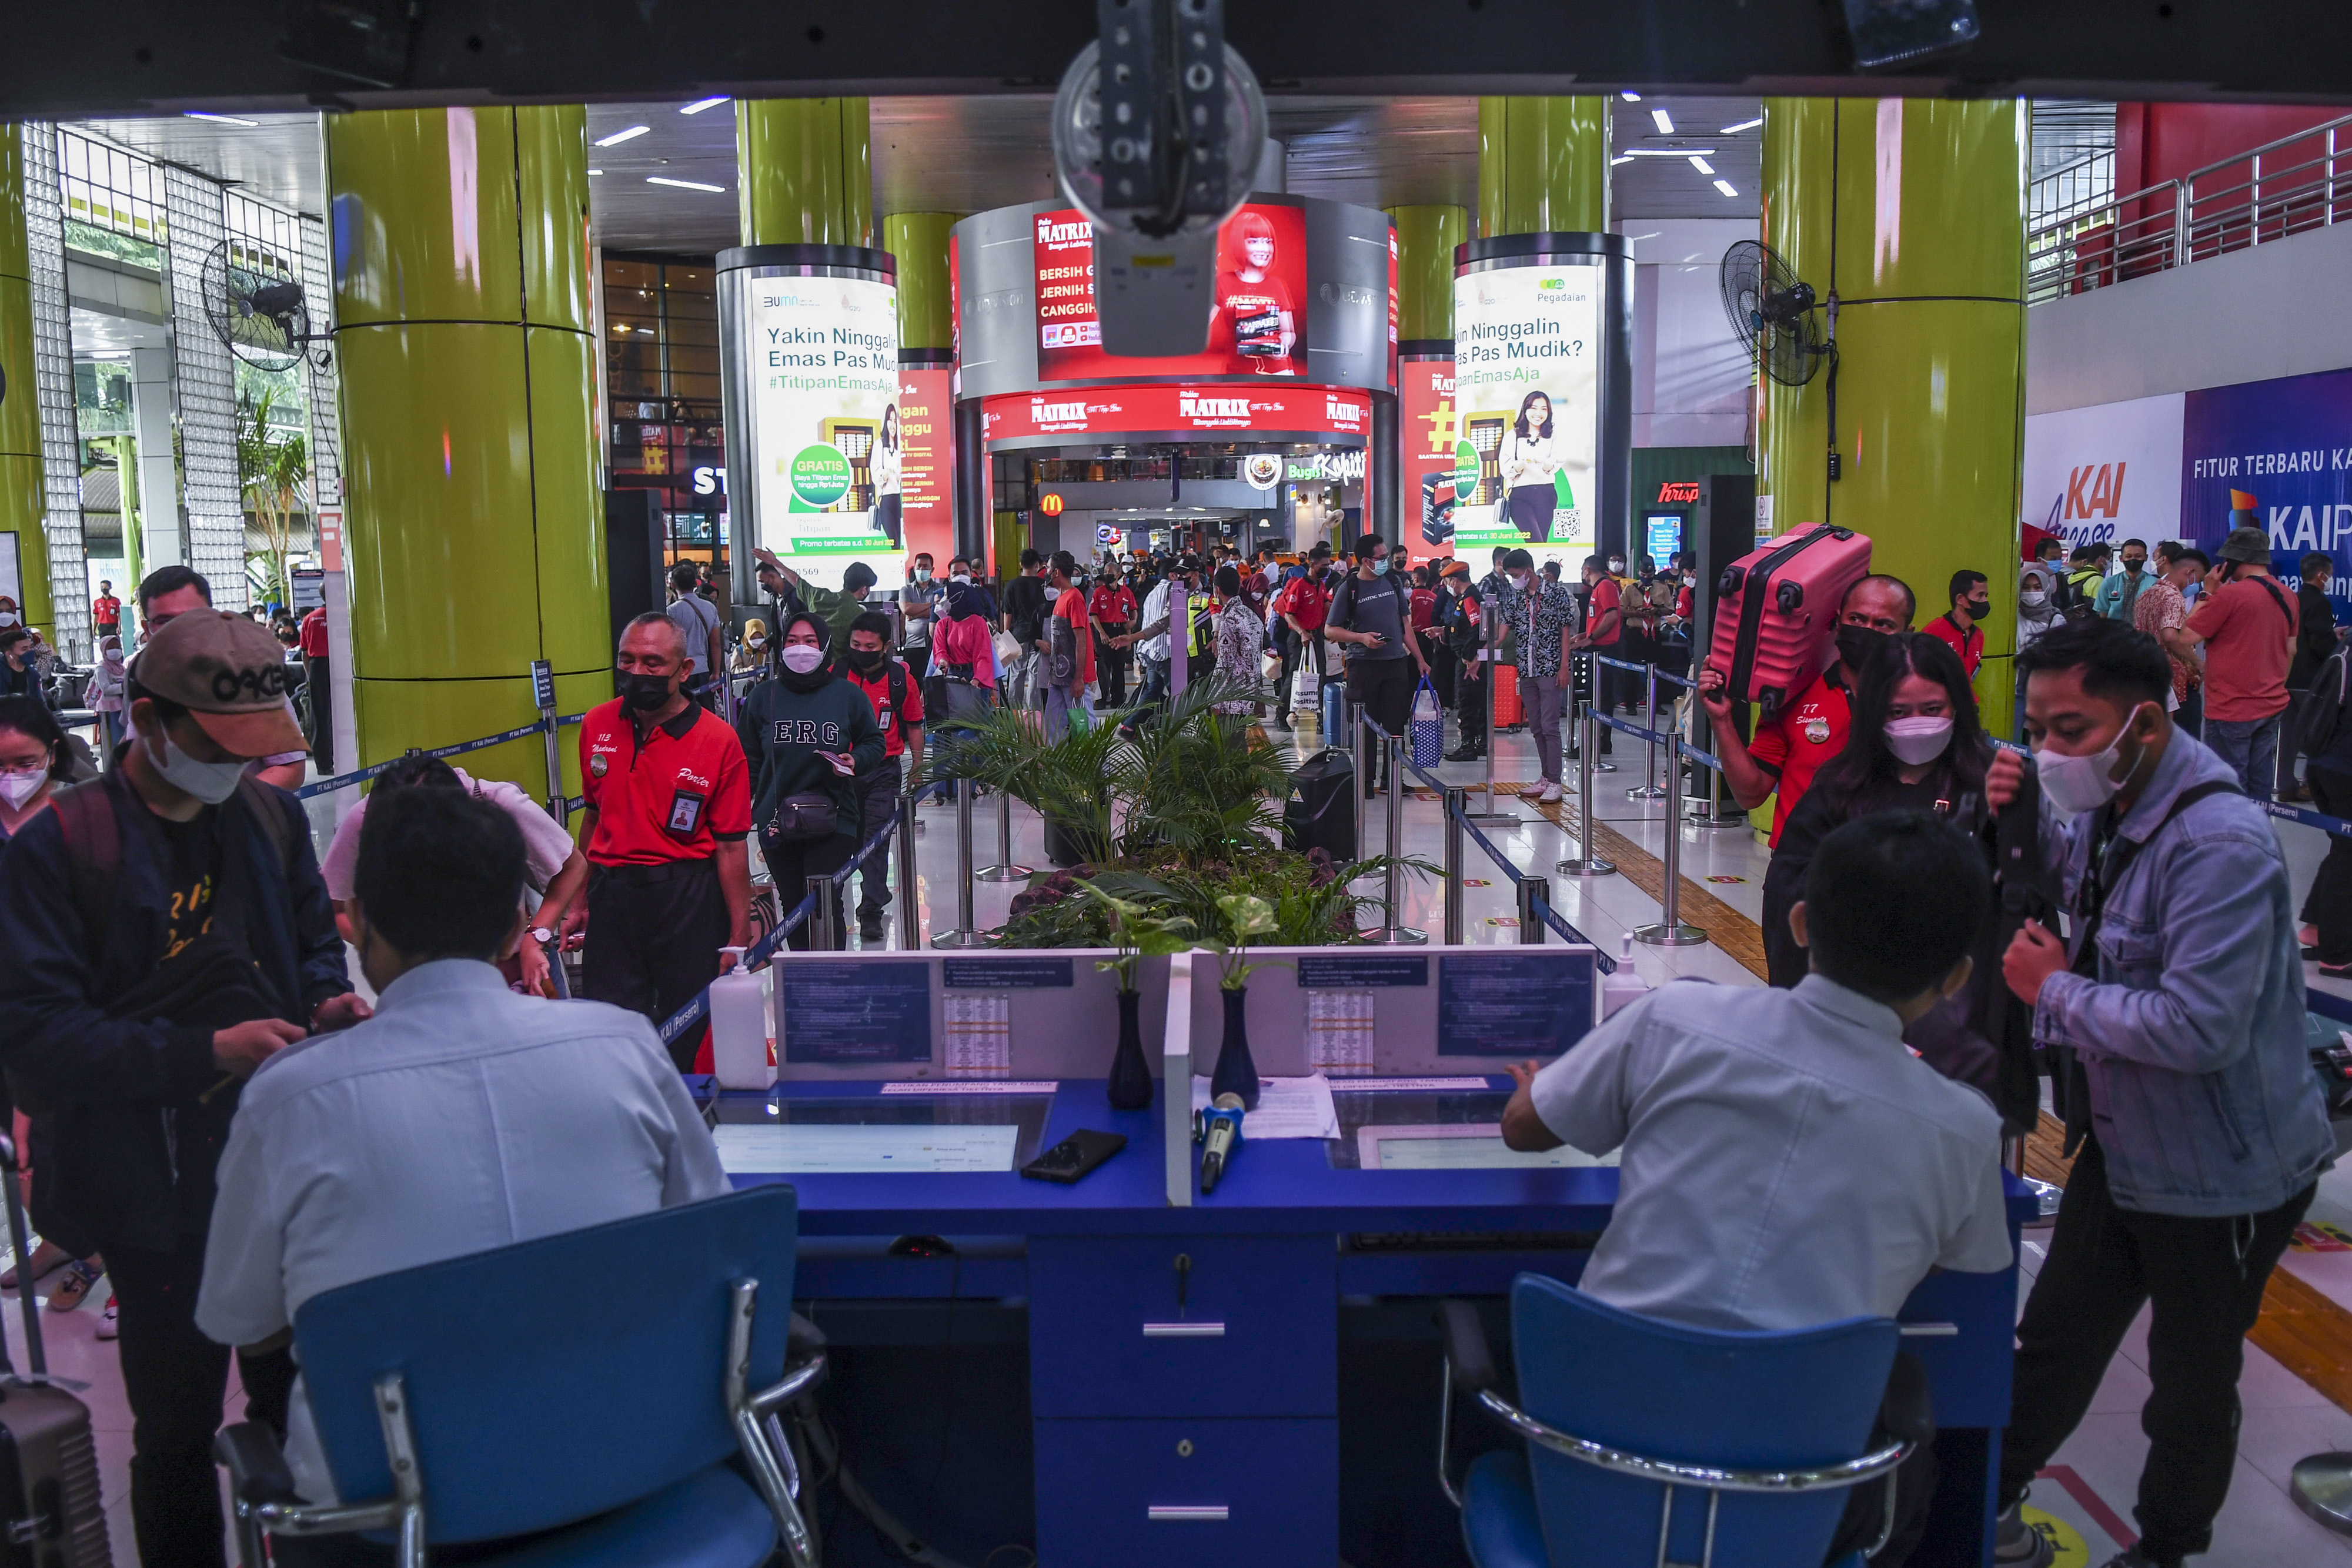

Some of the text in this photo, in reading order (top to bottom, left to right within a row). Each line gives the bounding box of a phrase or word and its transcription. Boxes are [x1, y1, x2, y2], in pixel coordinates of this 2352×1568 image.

[1038, 222, 1093, 243] MATRIX
[1040, 266, 1083, 280] BERSIH
[1040, 284, 1084, 299] JERNIH
[1538, 293, 1586, 303] Pegadaian
[768, 328, 824, 344] Yakin
[1472, 318, 1560, 341] Ninggalin
[1472, 339, 1583, 363] Pas Mudik?
[769, 350, 898, 372] Emas Pas Mud
[769, 375, 893, 393] #TitipanEmasAja
[1432, 379, 1455, 390] MAT
[1031, 403, 1087, 423] MATRIX
[1180, 399, 1251, 417] MATRIX
[1327, 402, 1360, 422] MATRIX
[797, 460, 843, 472] GRATIS
[1288, 464, 1321, 480] Bugis
[2194, 456, 2238, 479] FITUR
[2244, 449, 2323, 476] TERBARU
[1658, 483, 1699, 503] Krisp
[2064, 462, 2126, 519] KAI
[1357, 594, 1378, 604] FLOATING
[1803, 704, 1818, 714] 77
[774, 719, 839, 745] ERG
[324, 782, 332, 791] KAI
[333, 777, 351, 790] (Persero)
[677, 768, 709, 787] Porter
[2341, 823, 2352, 833] PT
[770, 907, 802, 946] PT KAI (Persero)
[660, 999, 699, 1041] KAI (Persero)
